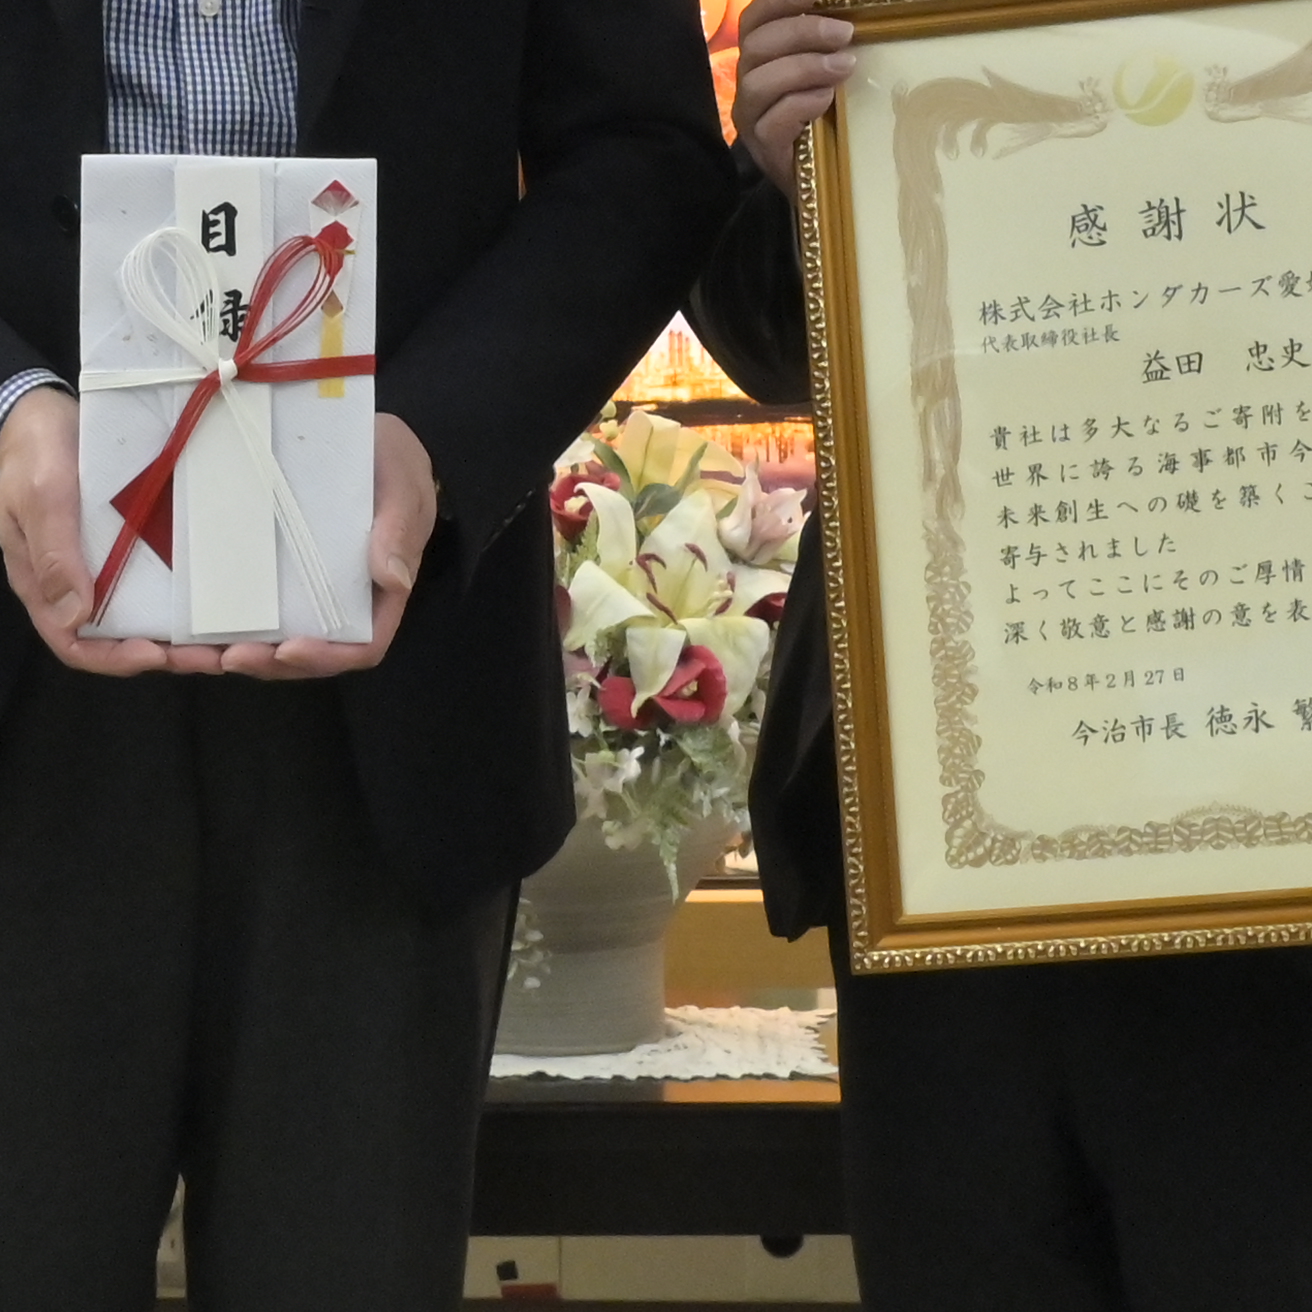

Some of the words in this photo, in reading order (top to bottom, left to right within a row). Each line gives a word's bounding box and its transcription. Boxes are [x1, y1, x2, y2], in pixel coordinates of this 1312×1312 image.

[1068, 190, 1266, 250] 感謝状
[980, 324, 1121, 354] 代表取締役社長
[1141, 349, 1204, 384] 益田
[1245, 337, 1312, 374] 忠史
[1000, 533, 1177, 571] 寄与されました
[1028, 666, 1186, 696] 令和8年2月27日
[1071, 712, 1189, 748] 今治市長
[1206, 699, 1275, 737] 徳永
